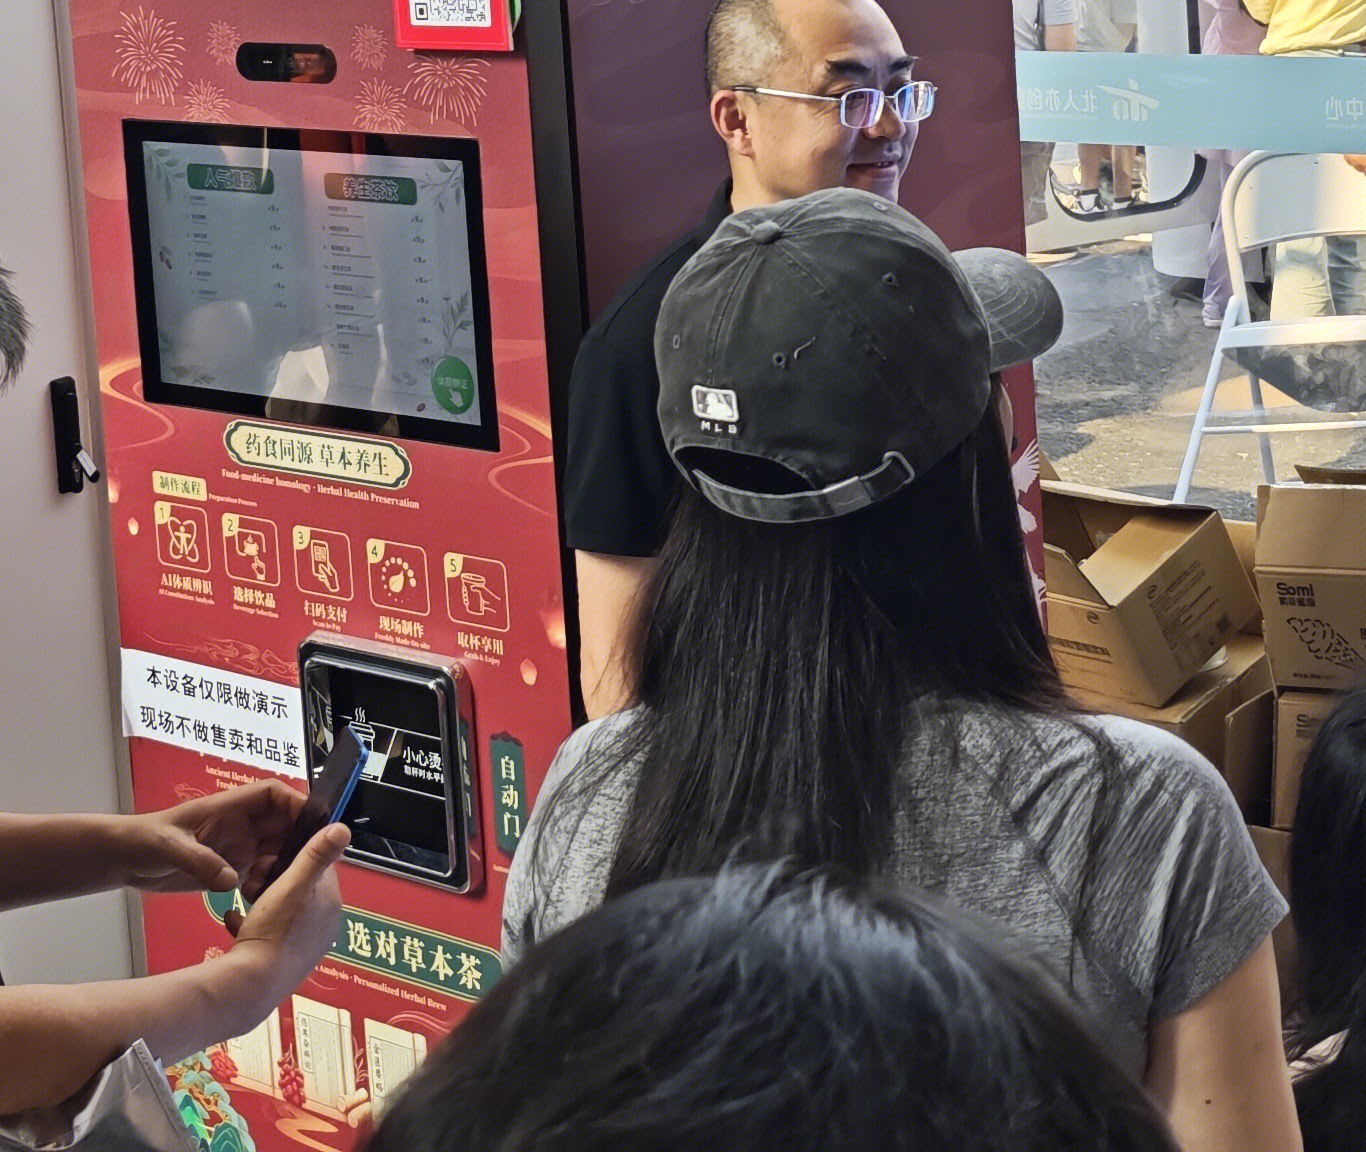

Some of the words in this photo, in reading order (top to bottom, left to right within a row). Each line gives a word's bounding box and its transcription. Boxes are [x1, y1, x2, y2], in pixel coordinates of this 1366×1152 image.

[701, 420, 737, 434] MLB
[246, 432, 313, 465] 药食同源
[317, 443, 390, 476] 草本养生
[159, 476, 201, 496] 制作流程
[221, 468, 275, 485] Food-medicine
[275, 476, 311, 493] homology
[317, 483, 343, 497] Herbal
[344, 487, 369, 501] Health
[370, 492, 420, 509] Preservation
[227, 518, 234, 532] 2
[297, 531, 304, 545] 3
[371, 544, 379, 558] 4
[450, 558, 457, 573] 5
[233, 585, 276, 608] 选择饮品
[304, 600, 347, 623] 扫码支付
[379, 615, 424, 638] 现场制作
[457, 631, 504, 655] 取杯享用
[146, 665, 289, 719] 本设备仅限做演示
[140, 705, 301, 768] 现场不做售卖和品鉴
[403, 746, 443, 771] 小心烫
[500, 755, 521, 838] 自动门
[346, 918, 483, 990] 选对草本茶
[319, 964, 349, 981] Analysis
[353, 974, 400, 997] Personalized
[401, 989, 426, 1005] Herbal
[427, 997, 447, 1012] Brew
